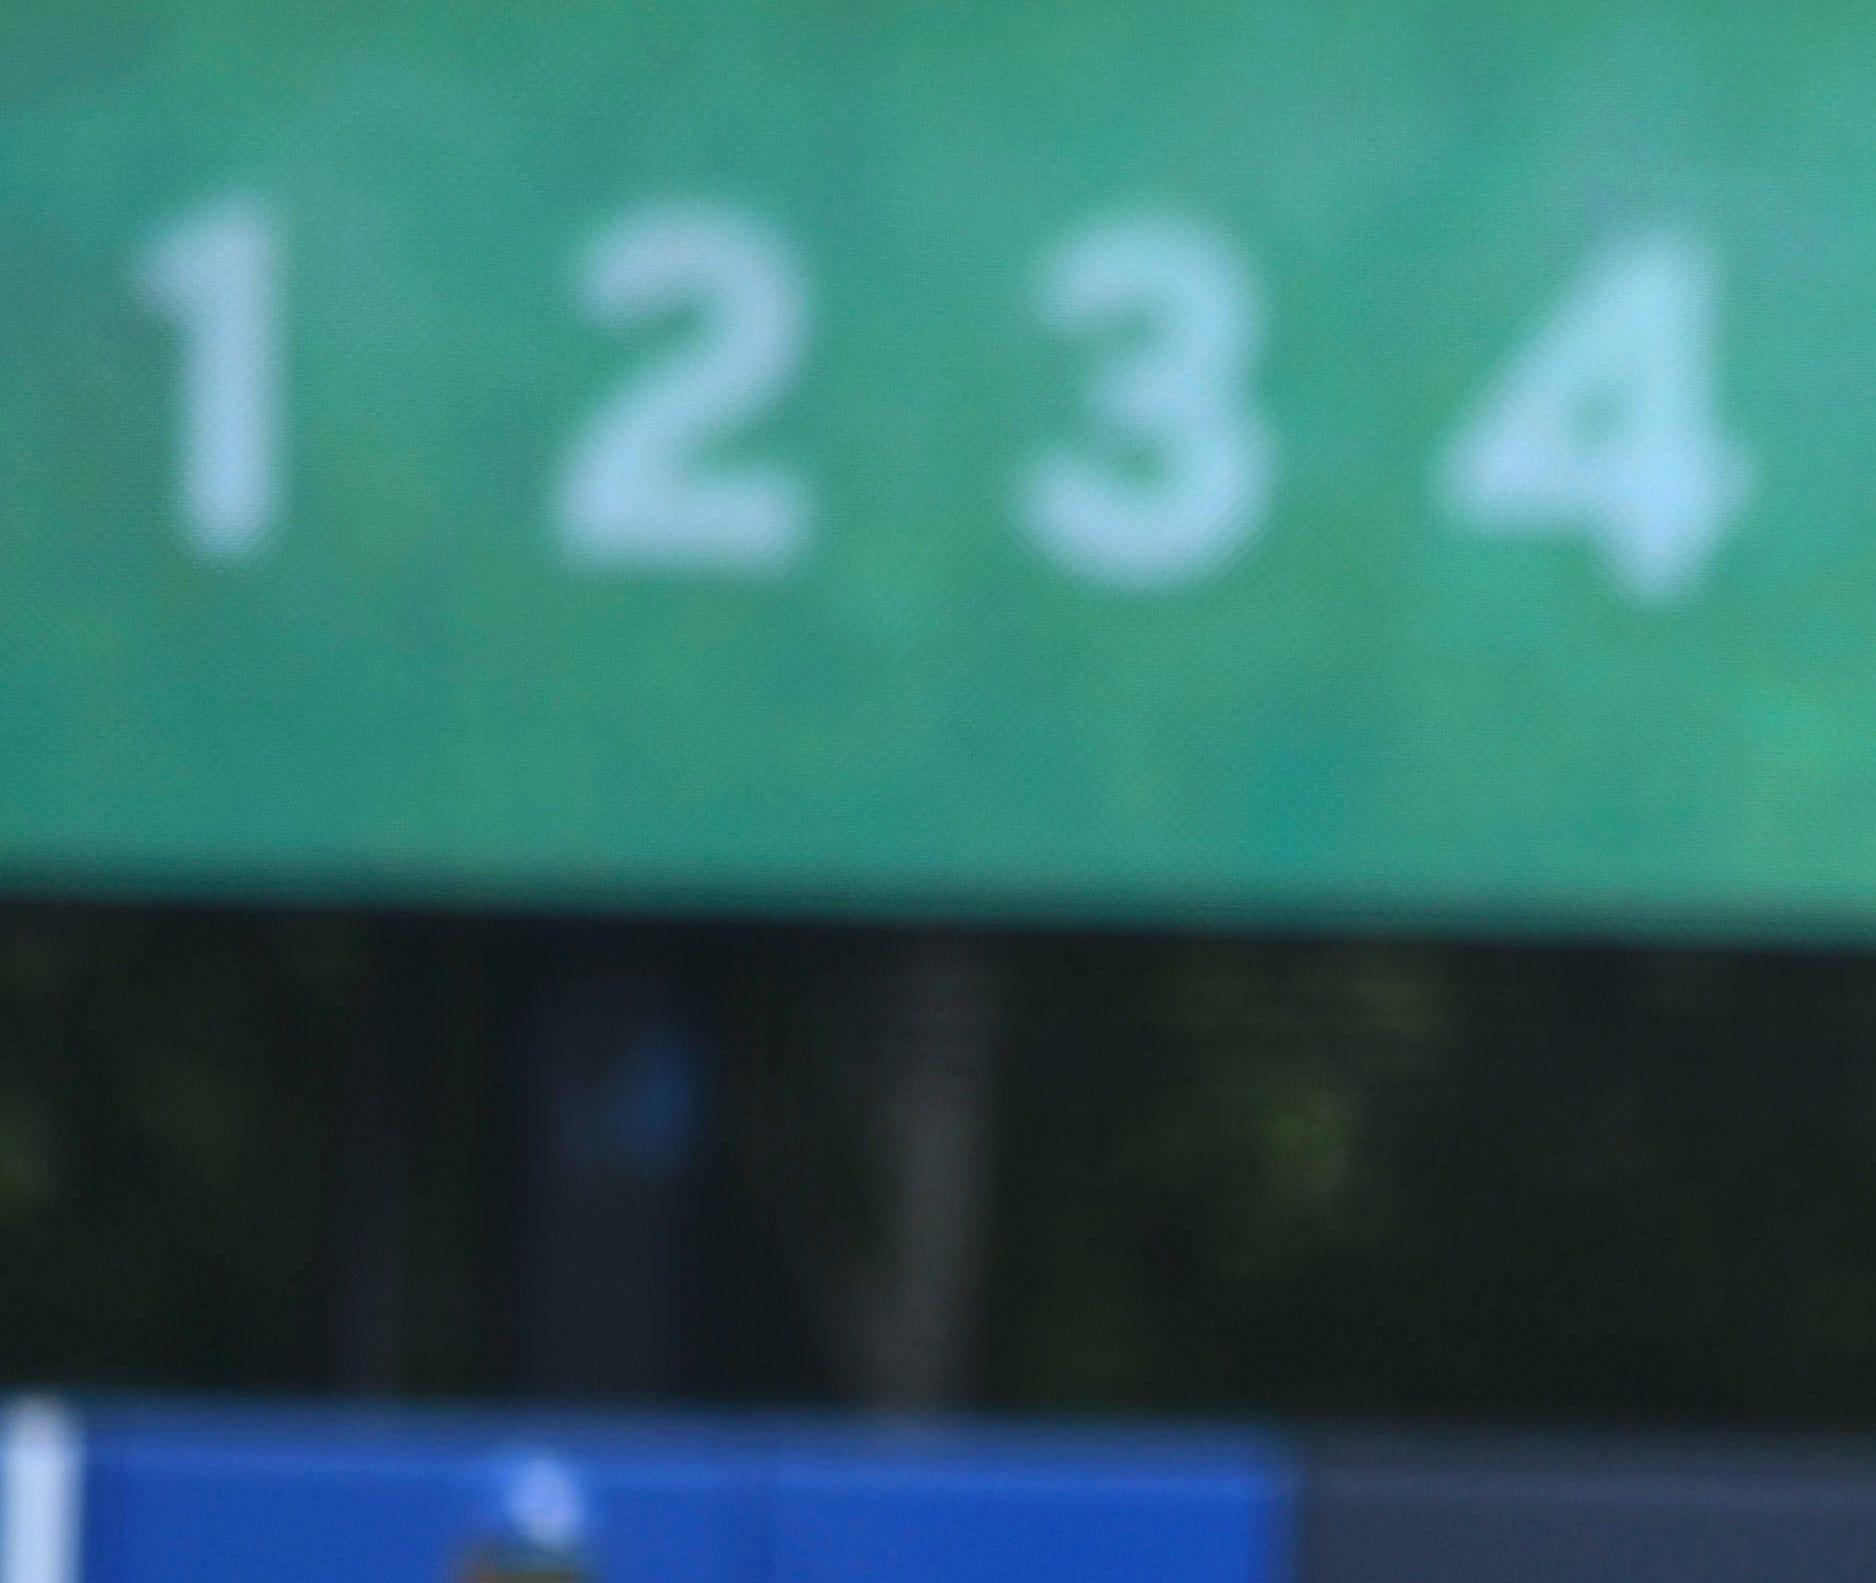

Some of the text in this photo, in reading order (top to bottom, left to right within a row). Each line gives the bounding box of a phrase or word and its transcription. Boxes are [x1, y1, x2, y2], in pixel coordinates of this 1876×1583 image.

[141, 197, 279, 557] 1
[566, 201, 811, 572] 2
[1029, 209, 1272, 586] 3
[1447, 232, 1746, 595] 4
